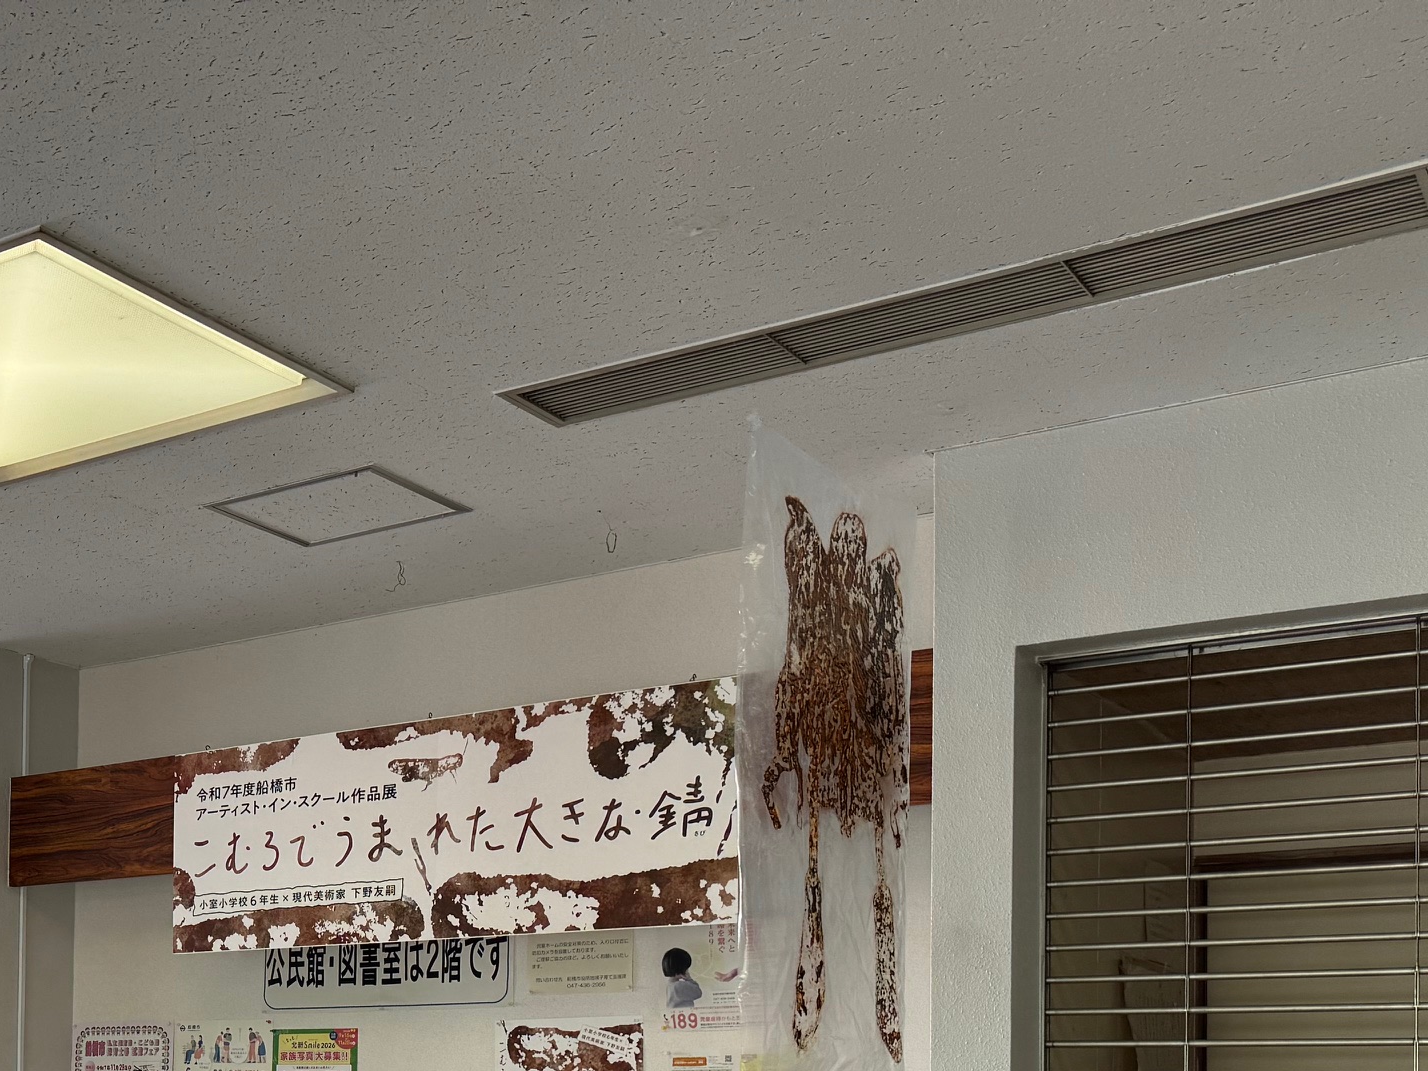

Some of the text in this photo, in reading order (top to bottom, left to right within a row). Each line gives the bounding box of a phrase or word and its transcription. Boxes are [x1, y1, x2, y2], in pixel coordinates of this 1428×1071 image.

[196, 777, 297, 803] 令和7年度船橋市
[196, 783, 397, 821] アーティスト・イン・スクール作品展
[267, 936, 508, 988] 公民館・図書室は2階です
[670, 1013, 698, 1029] 189
